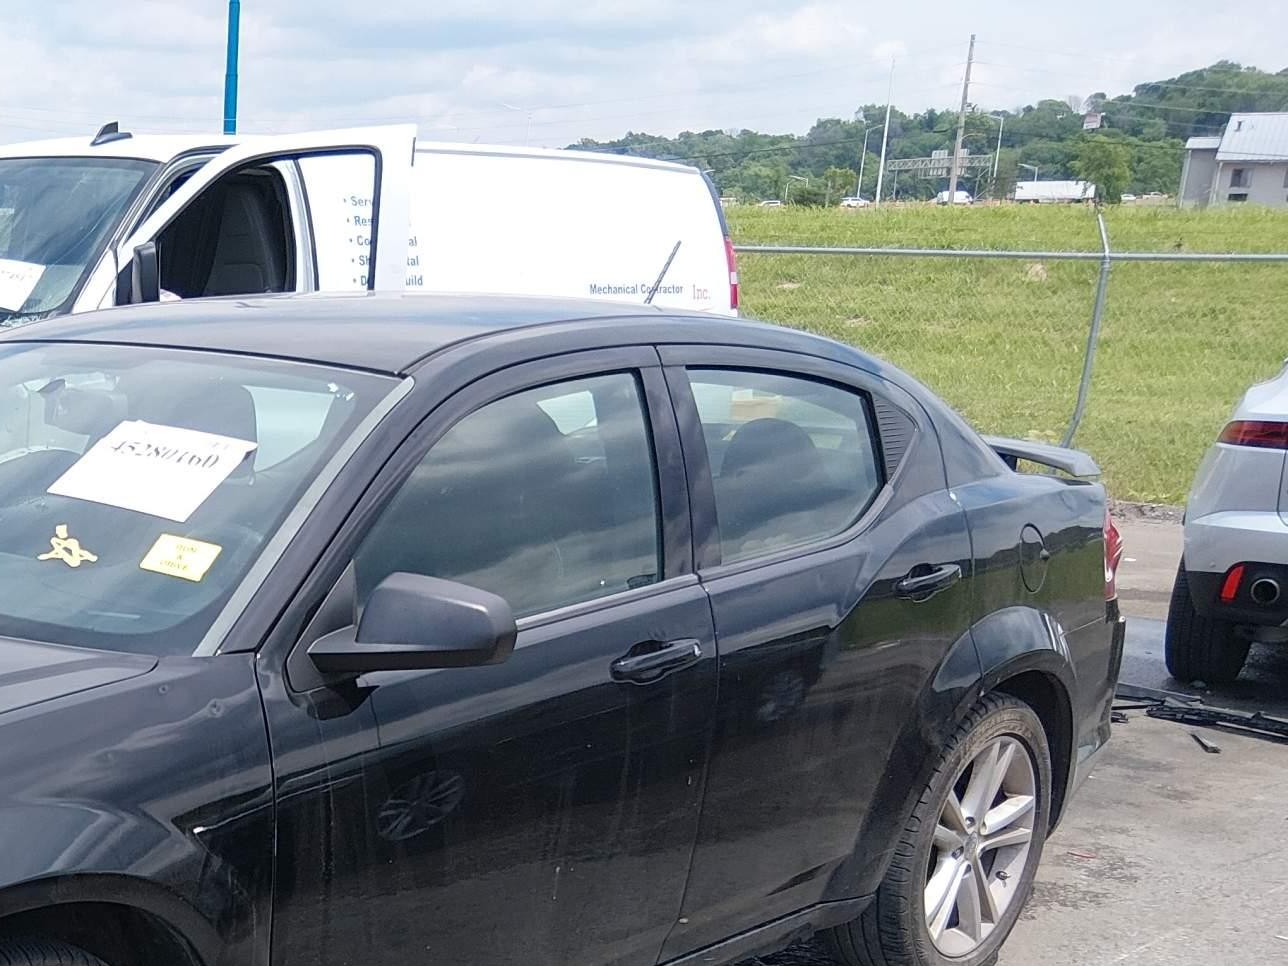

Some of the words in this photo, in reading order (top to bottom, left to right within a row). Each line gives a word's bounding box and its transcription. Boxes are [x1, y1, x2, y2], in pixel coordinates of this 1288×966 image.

[589, 284, 638, 295] Mechanical
[641, 284, 684, 294] Cotractor
[692, 284, 711, 300] Inc.
